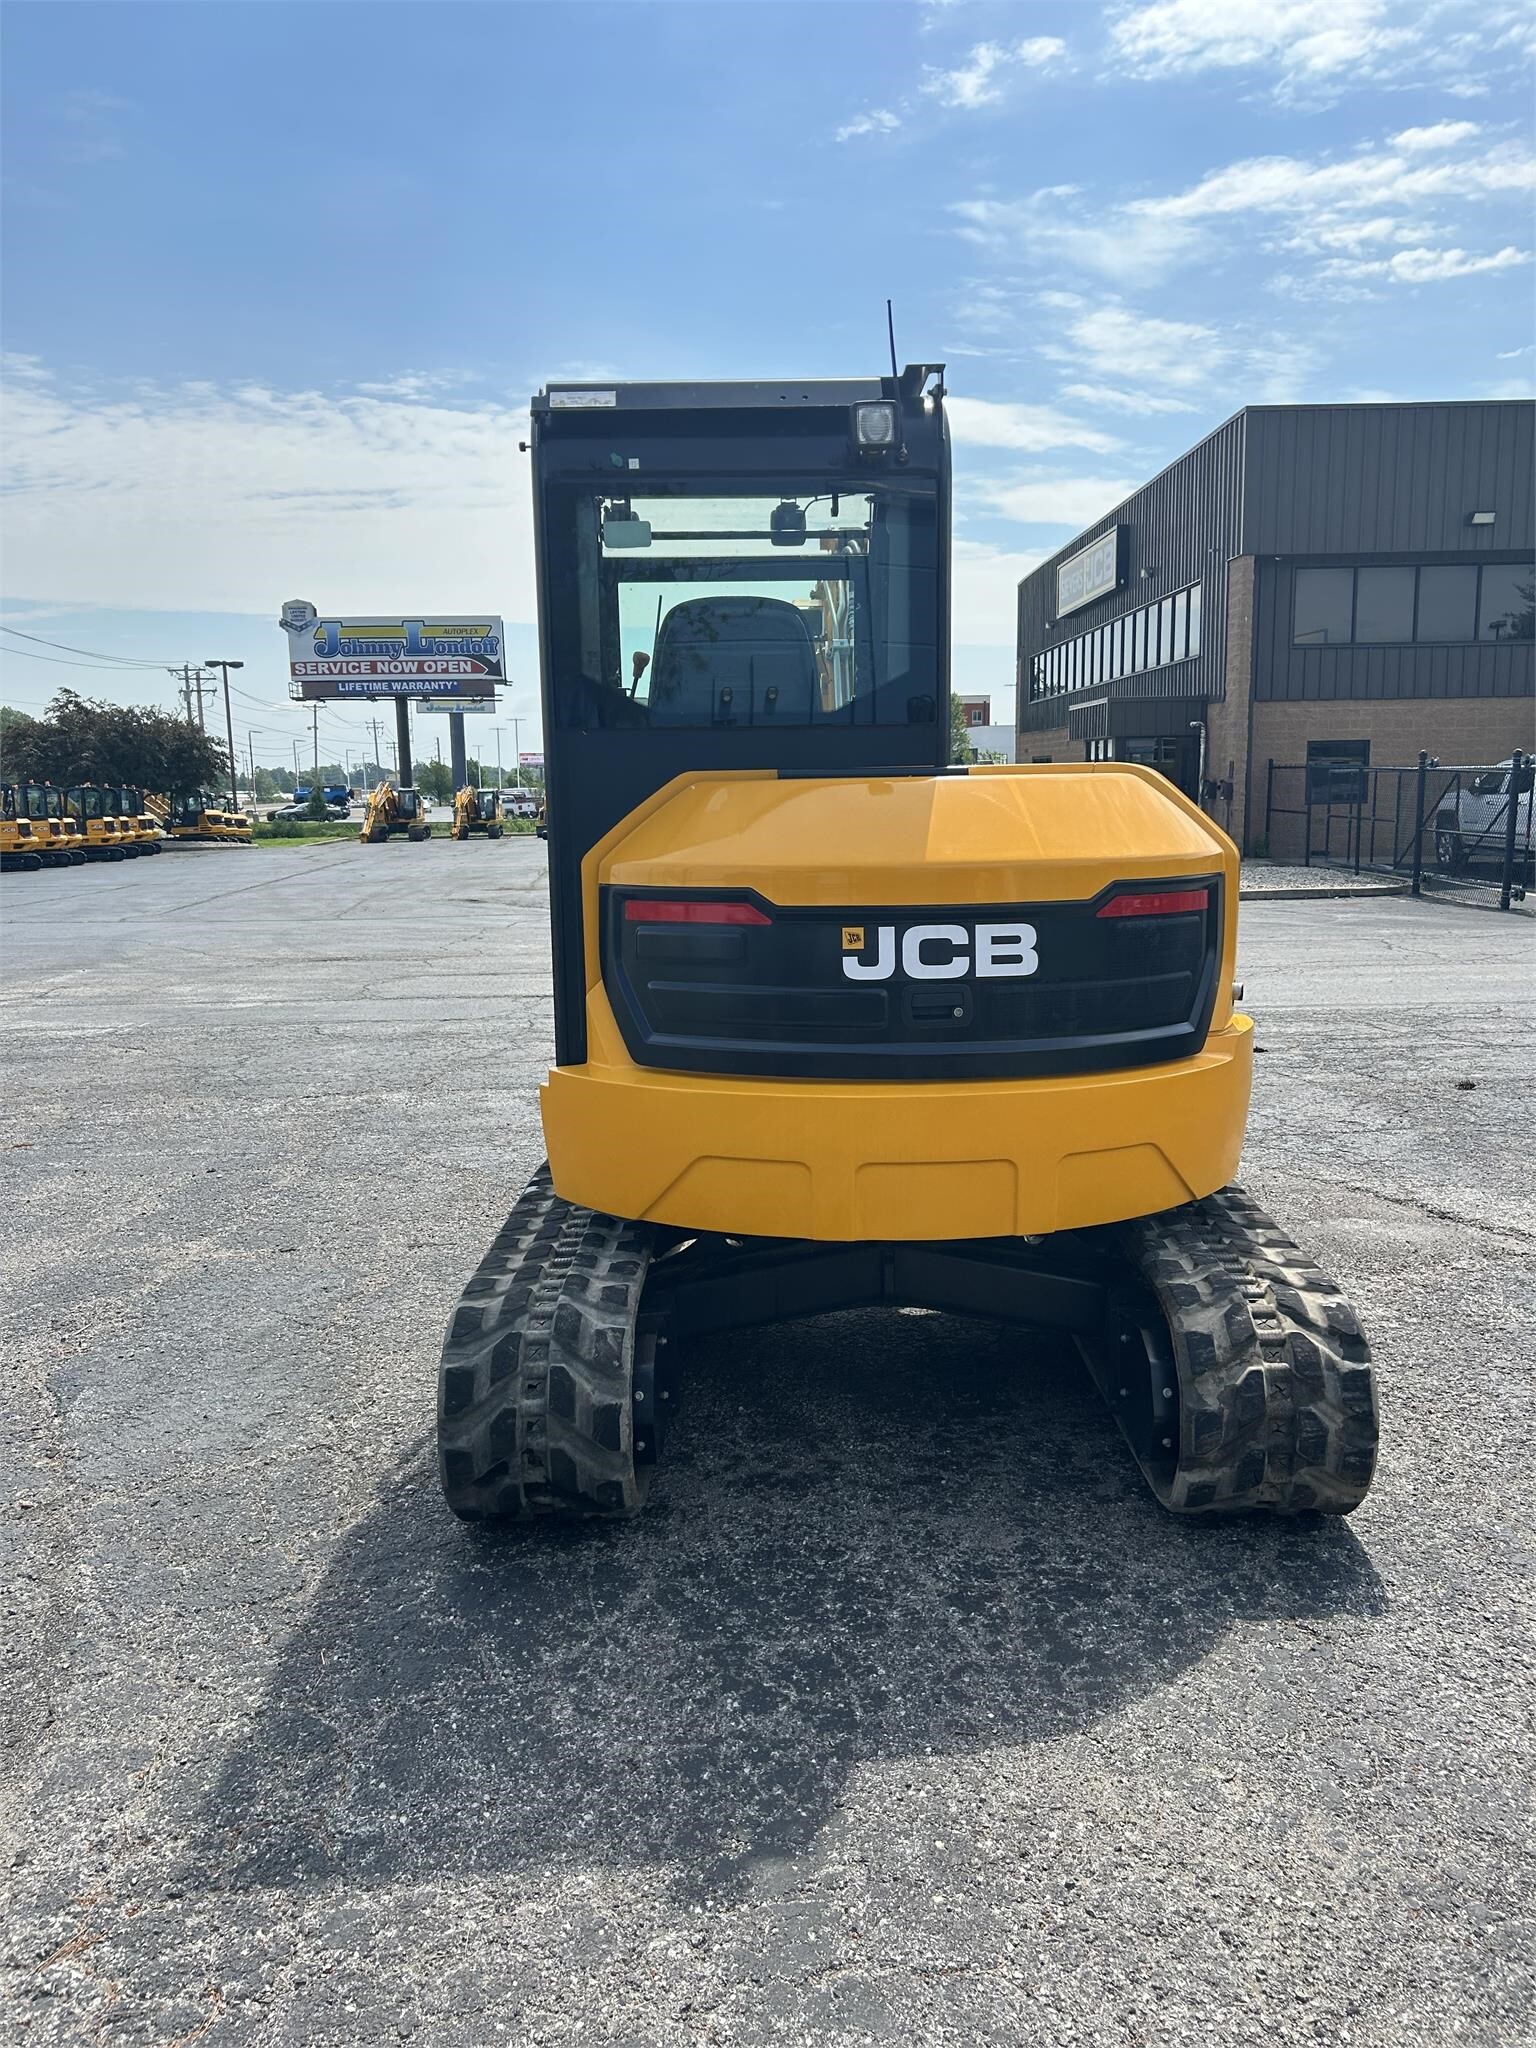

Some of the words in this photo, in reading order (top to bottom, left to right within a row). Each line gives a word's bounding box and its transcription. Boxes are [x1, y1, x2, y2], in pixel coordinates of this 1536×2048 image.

[314, 622, 404, 659] Johnny
[403, 621, 499, 656] Londoff
[295, 662, 371, 675] SERVICE
[377, 661, 418, 674] NOW
[423, 661, 471, 673] OPEN
[339, 682, 389, 691] LIFETIME
[842, 923, 1039, 980] JCB
